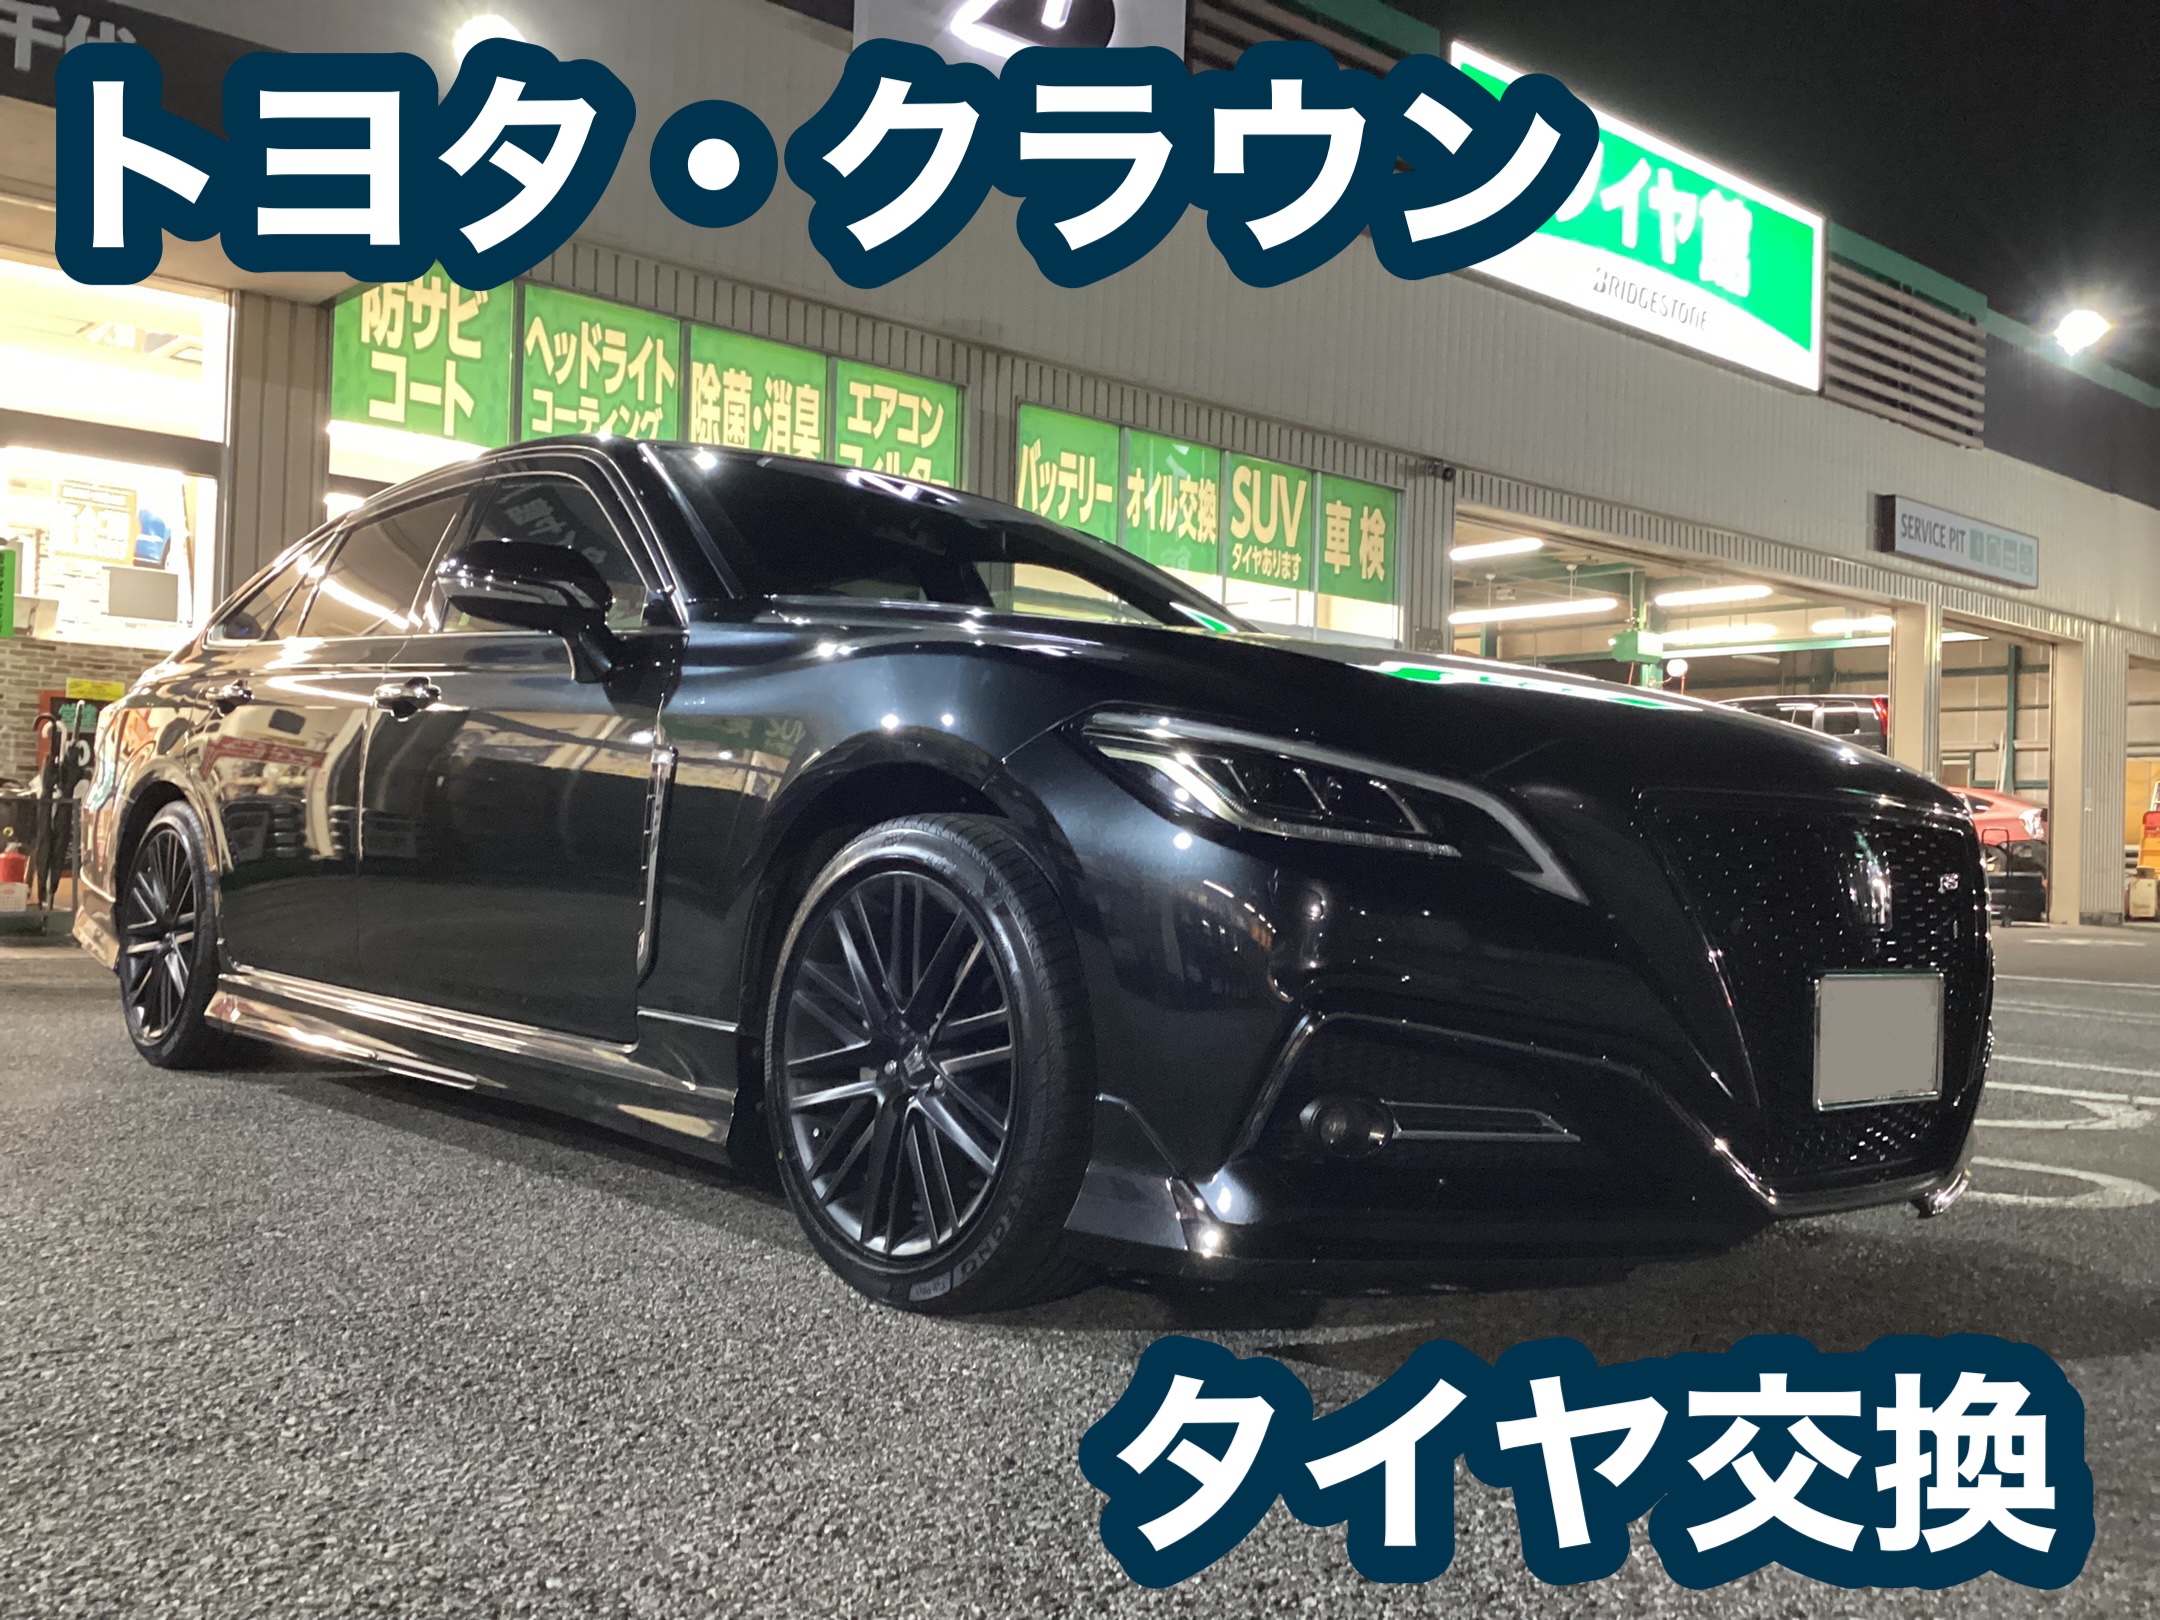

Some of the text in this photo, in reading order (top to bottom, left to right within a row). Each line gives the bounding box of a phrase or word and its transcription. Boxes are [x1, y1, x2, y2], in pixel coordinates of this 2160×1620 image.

[360, 275, 489, 360] 防サビ
[1592, 266, 1708, 331] BRIDGESTONE
[368, 350, 475, 437] コート
[525, 316, 676, 405] ヘッドライト
[847, 381, 944, 449] エアコン
[1017, 438, 1113, 523] バッテリー
[1126, 467, 1217, 545] オイル交換
[1230, 465, 1307, 548] SUV
[1231, 542, 1302, 582] タイヤあります
[1324, 500, 1386, 582] 車検
[1900, 512, 1967, 554] SERVICE PIT
